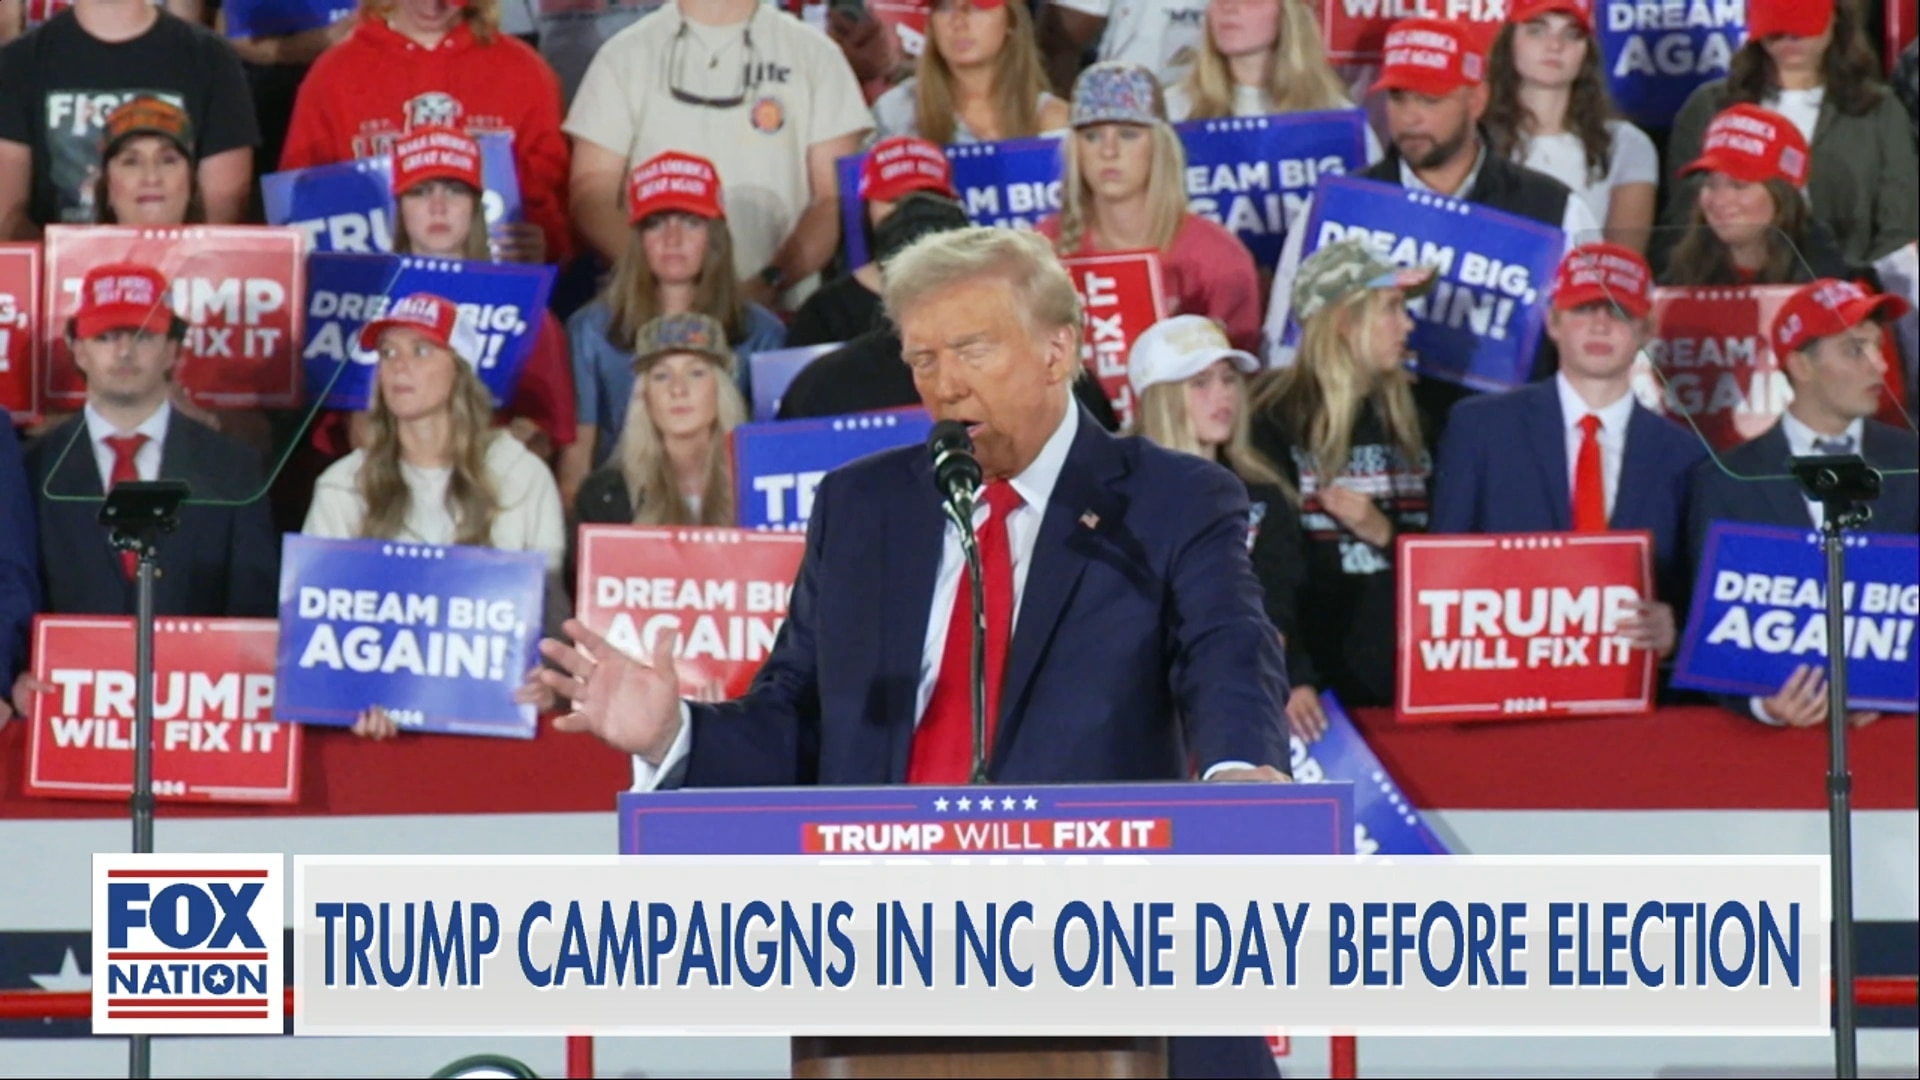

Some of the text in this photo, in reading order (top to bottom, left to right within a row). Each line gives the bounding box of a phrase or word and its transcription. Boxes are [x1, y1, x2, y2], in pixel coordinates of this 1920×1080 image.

[1608, 0, 1746, 32] DREAM
[1612, 32, 1750, 77] AGA
[1186, 161, 1271, 195] EAM
[1084, 270, 1119, 307] IT
[1459, 251, 1537, 306] BIG,
[243, 328, 282, 358] IT
[1090, 313, 1127, 379] FIX
[1650, 335, 1758, 369] REAM
[596, 576, 738, 612] DREAM
[1418, 585, 1642, 638] TRUMP
[299, 586, 527, 640] DREAM BIG,
[298, 623, 508, 682] AGAIN!
[1419, 635, 1634, 672] WILL FIX IT
[50, 668, 277, 721] TRUMP
[50, 716, 280, 754] WIL FIX IT
[817, 820, 1156, 852] TRUMP WILL FIX IT
